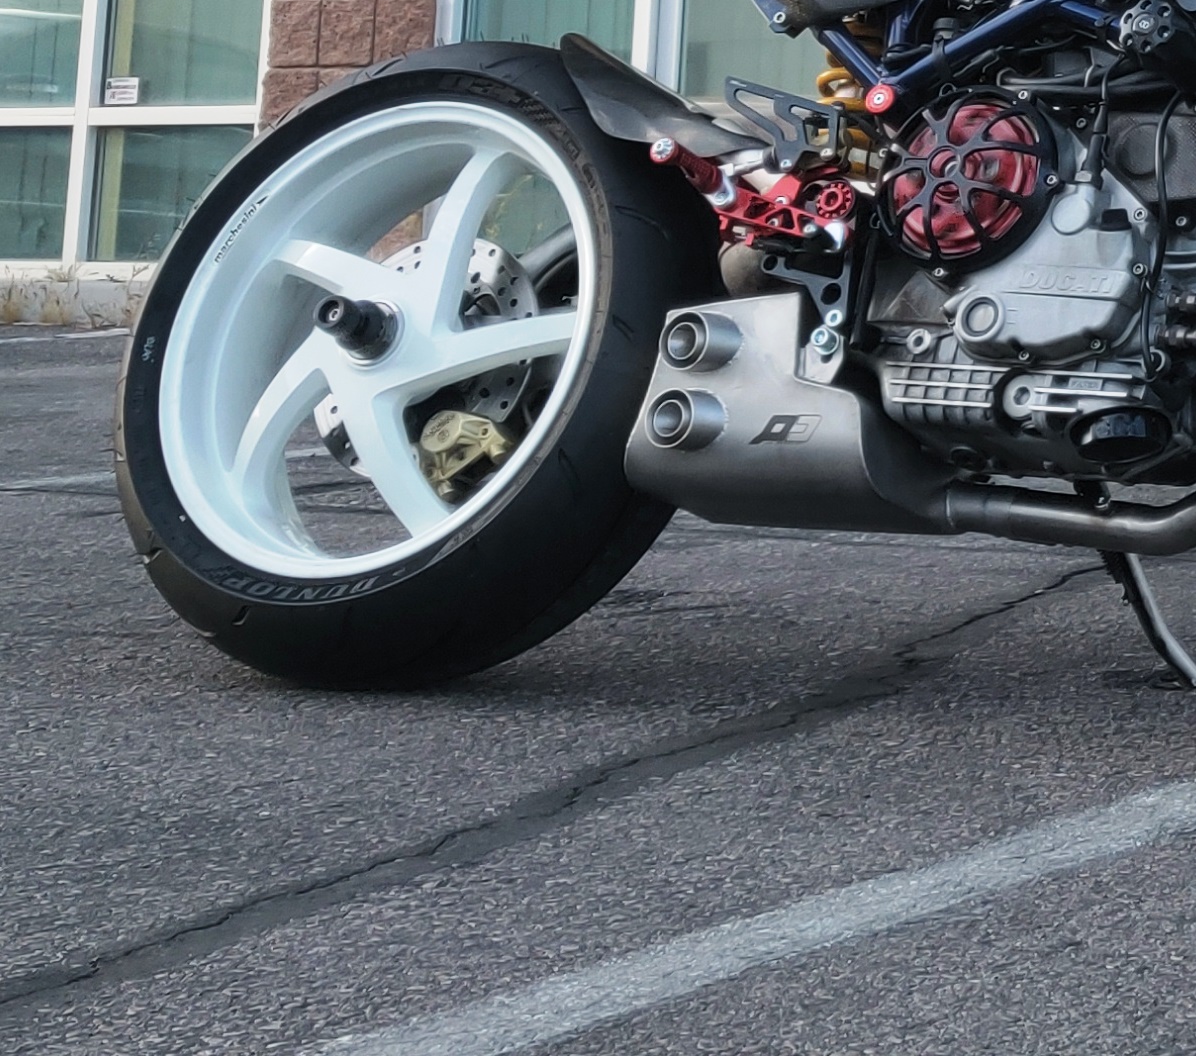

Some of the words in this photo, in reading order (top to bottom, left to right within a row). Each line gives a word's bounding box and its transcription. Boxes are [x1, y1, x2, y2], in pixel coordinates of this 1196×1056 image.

[213, 203, 258, 264] marchesini
[1019, 266, 1114, 294] DUCATI
[221, 576, 381, 601] DUNLOP
